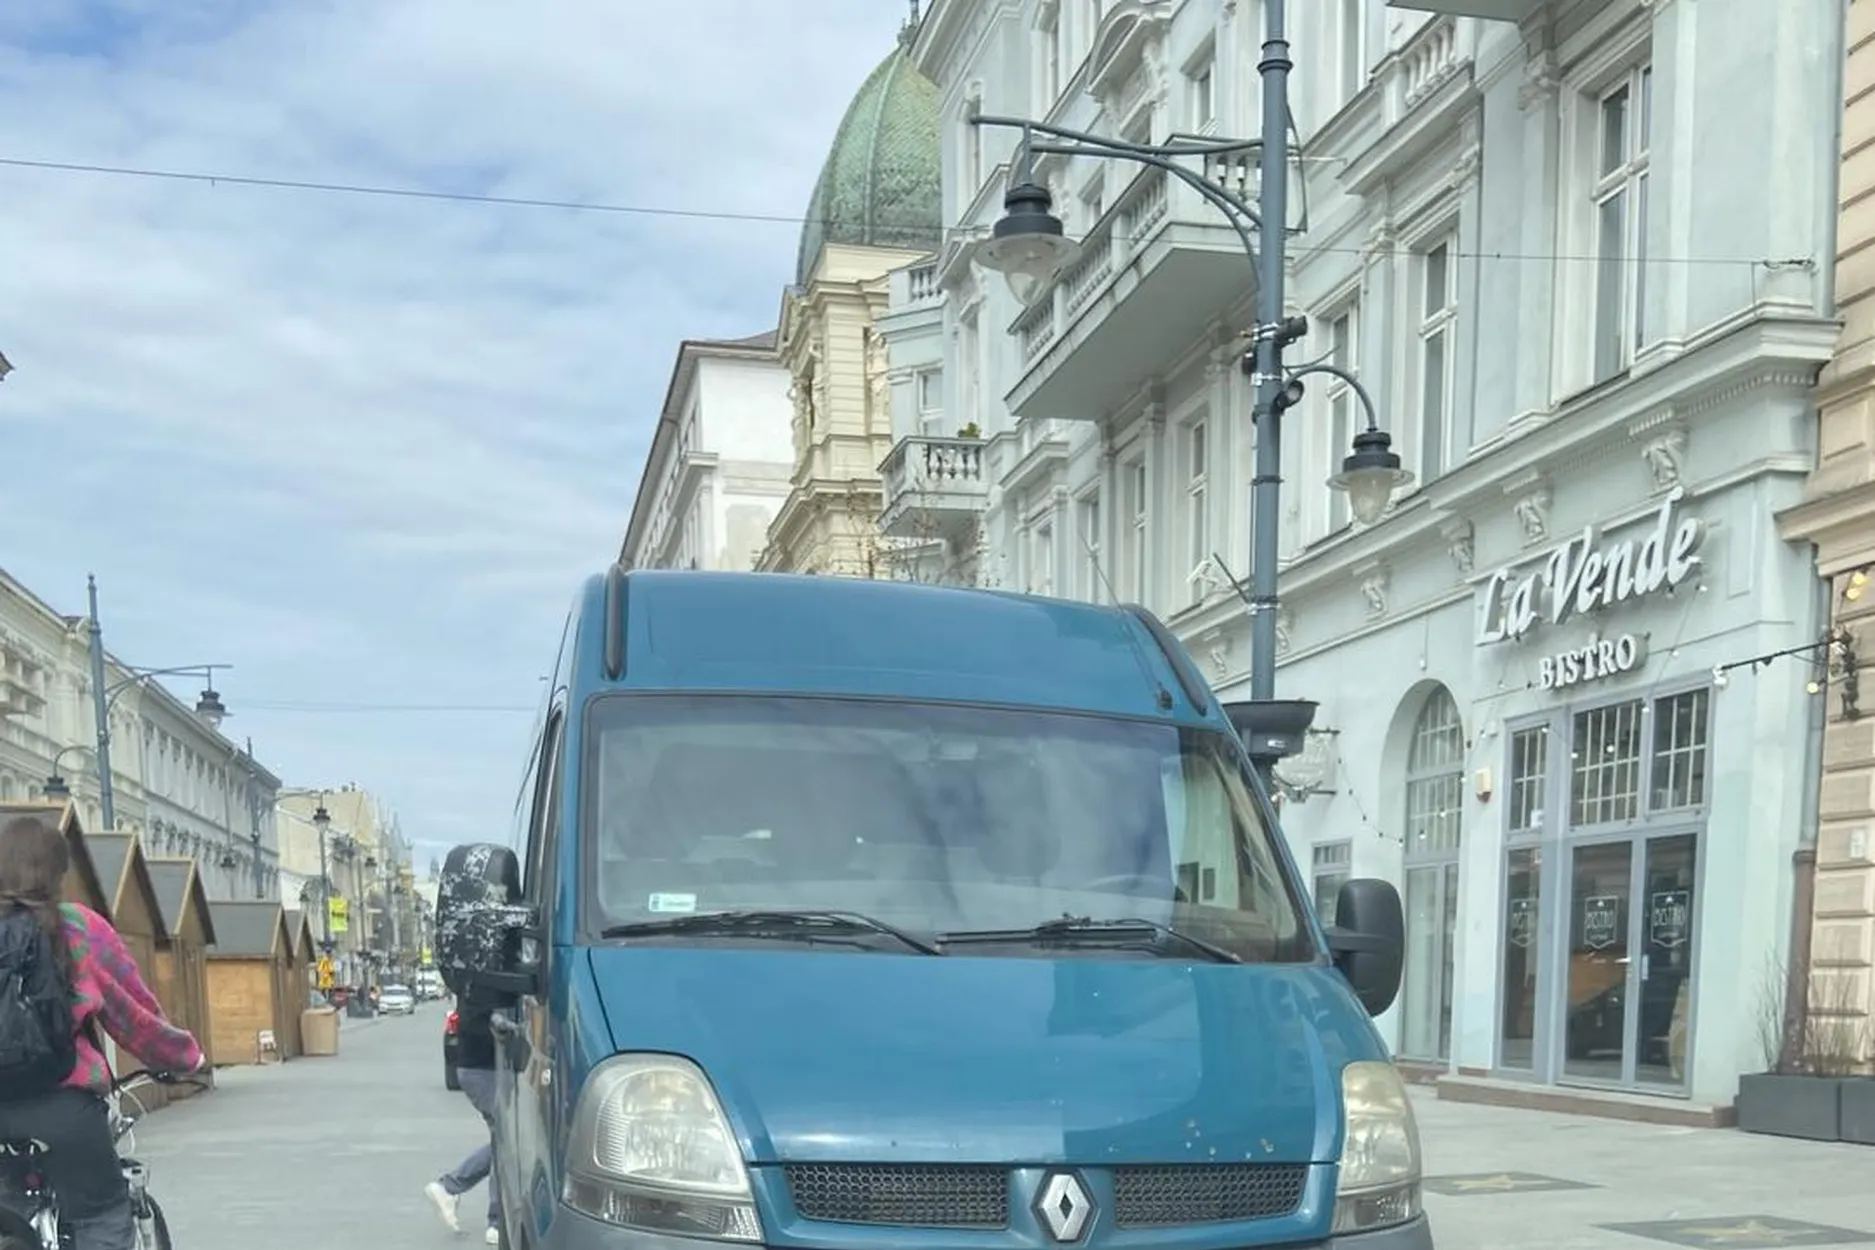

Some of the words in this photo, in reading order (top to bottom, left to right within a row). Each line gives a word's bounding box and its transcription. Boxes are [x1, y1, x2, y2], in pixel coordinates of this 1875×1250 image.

[1475, 568, 1539, 646] La
[1543, 486, 1702, 625] Vende
[1538, 633, 1637, 690] BISTRO
